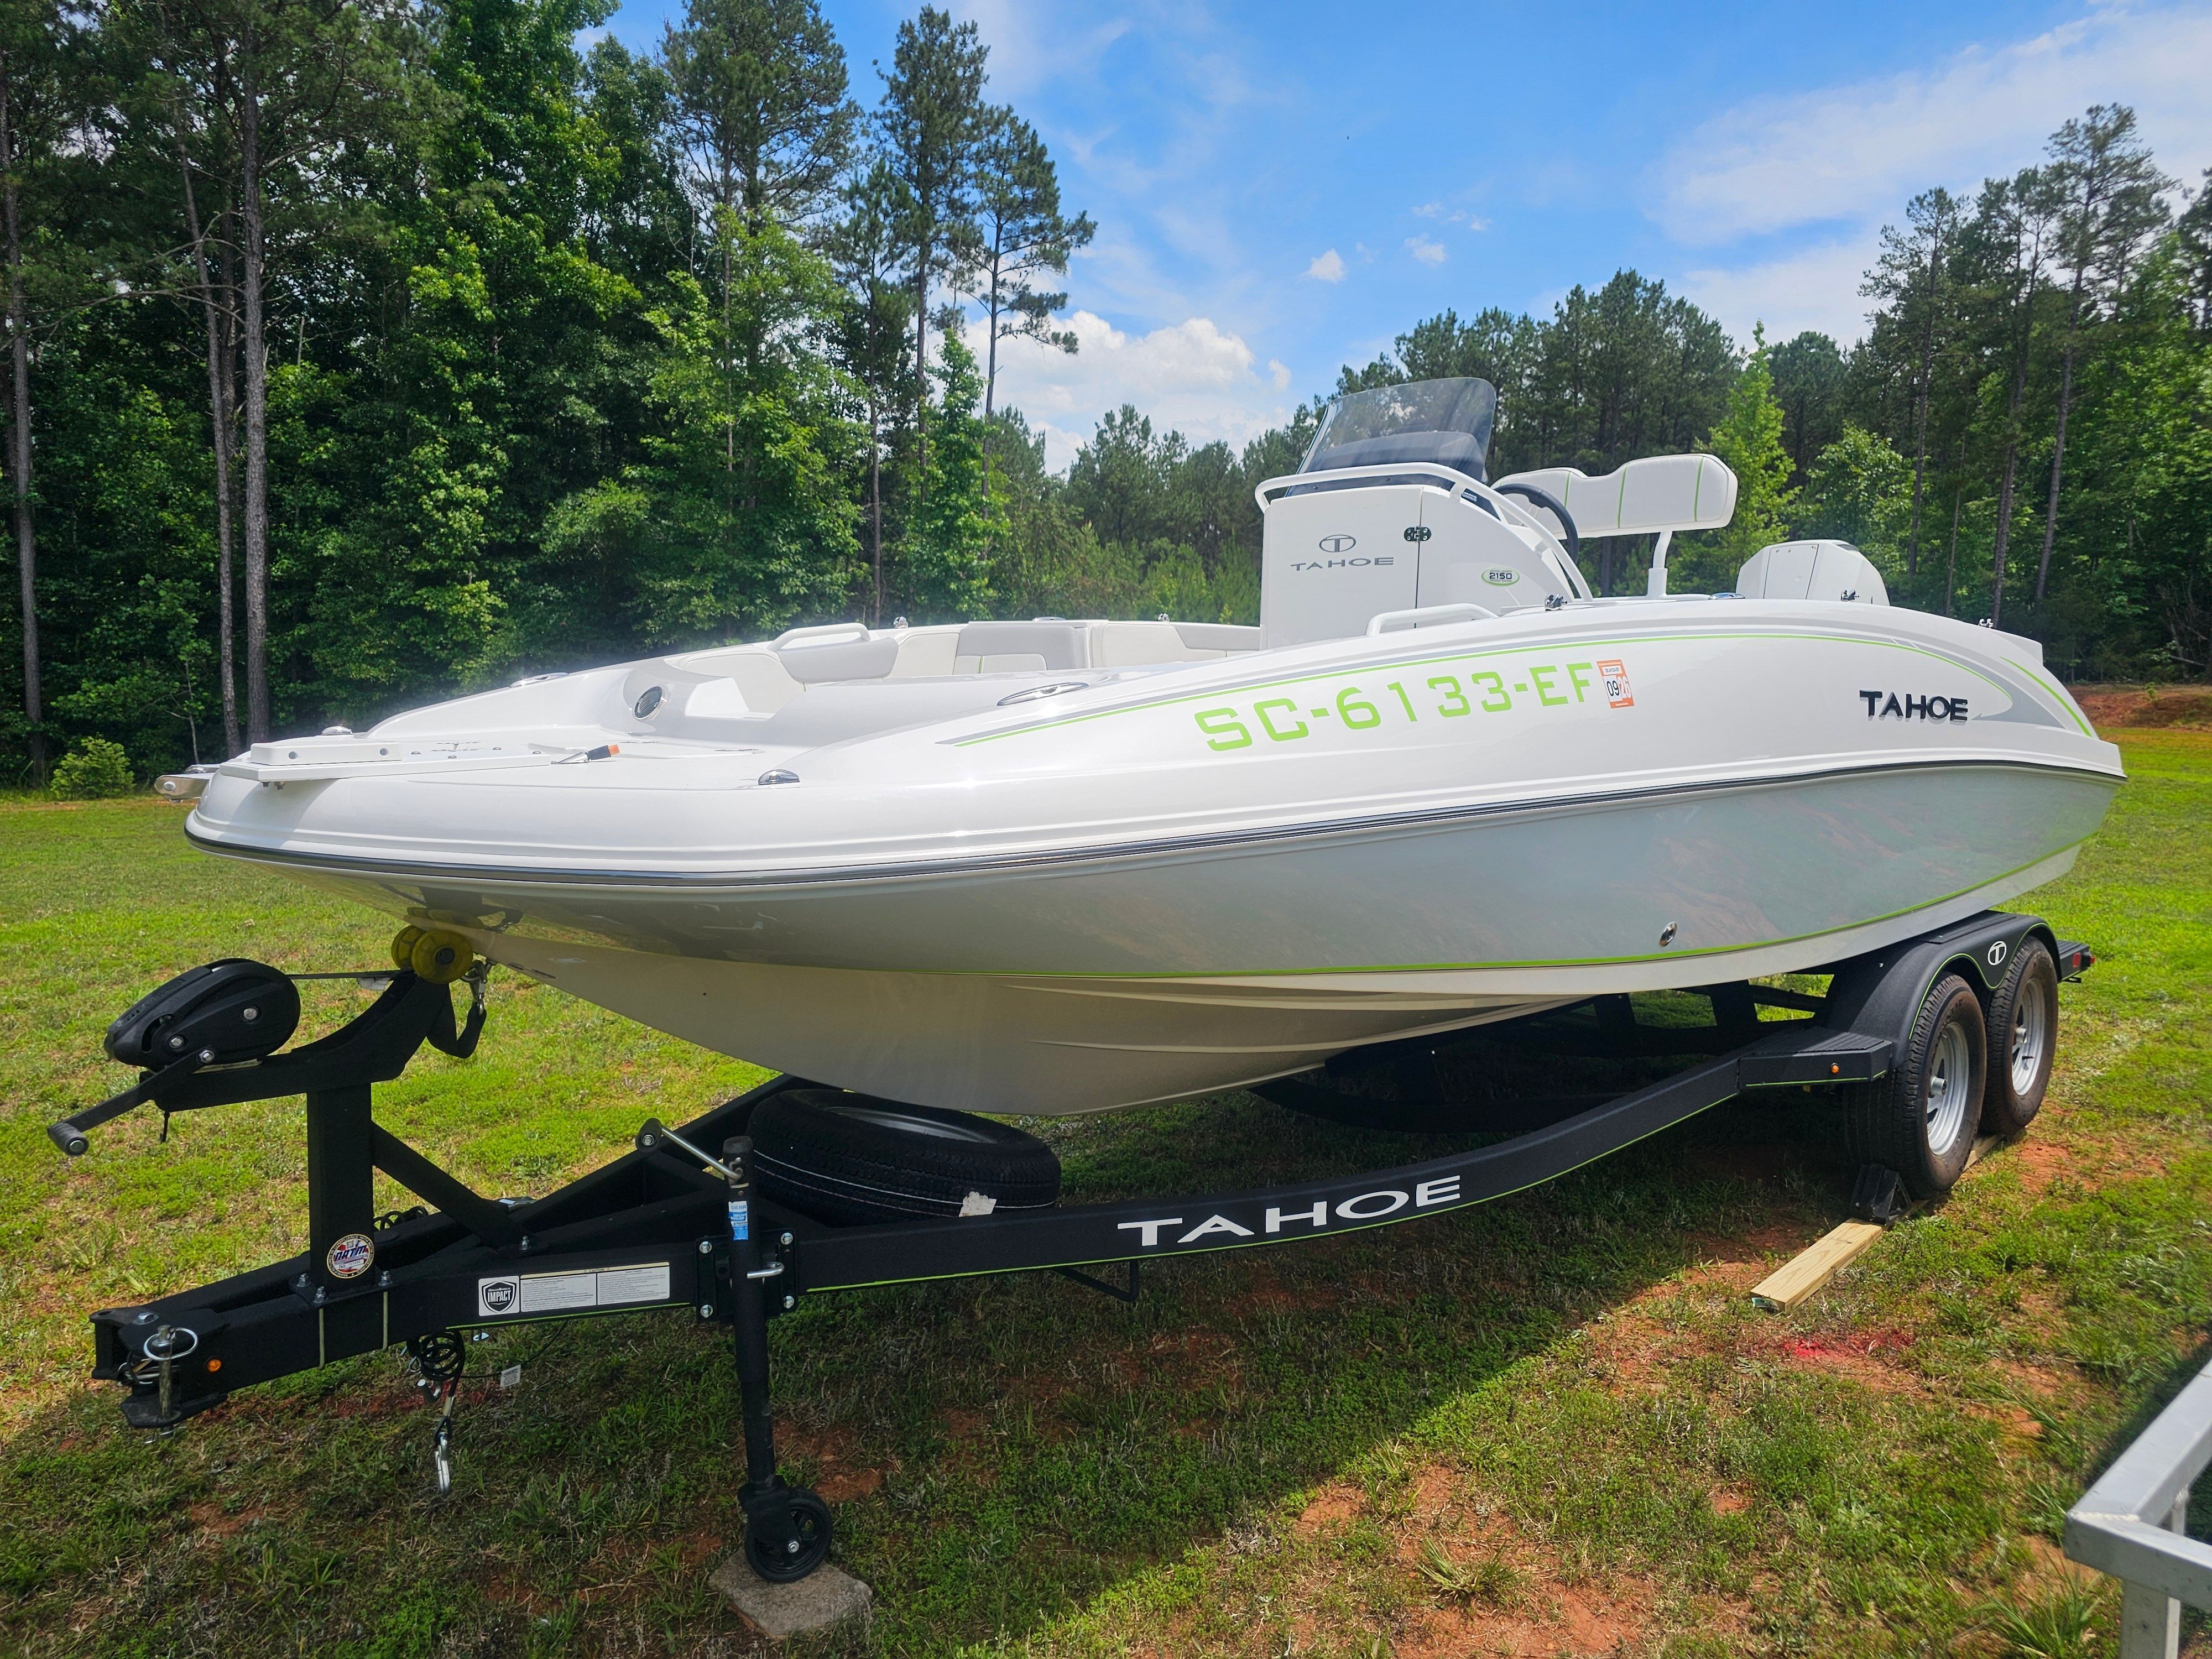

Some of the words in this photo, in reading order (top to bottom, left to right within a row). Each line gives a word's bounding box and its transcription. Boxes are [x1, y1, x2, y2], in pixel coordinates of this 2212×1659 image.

[1290, 557, 1394, 572] TAHOE
[1606, 680, 1620, 697] 09
[1617, 676, 1632, 699] 26
[1194, 662, 1594, 752] SC-6133-EF
[1859, 690, 1969, 722] TAHOE
[1117, 1175, 1460, 1247] TAHOE
[487, 1290, 512, 1303] IMPACT
